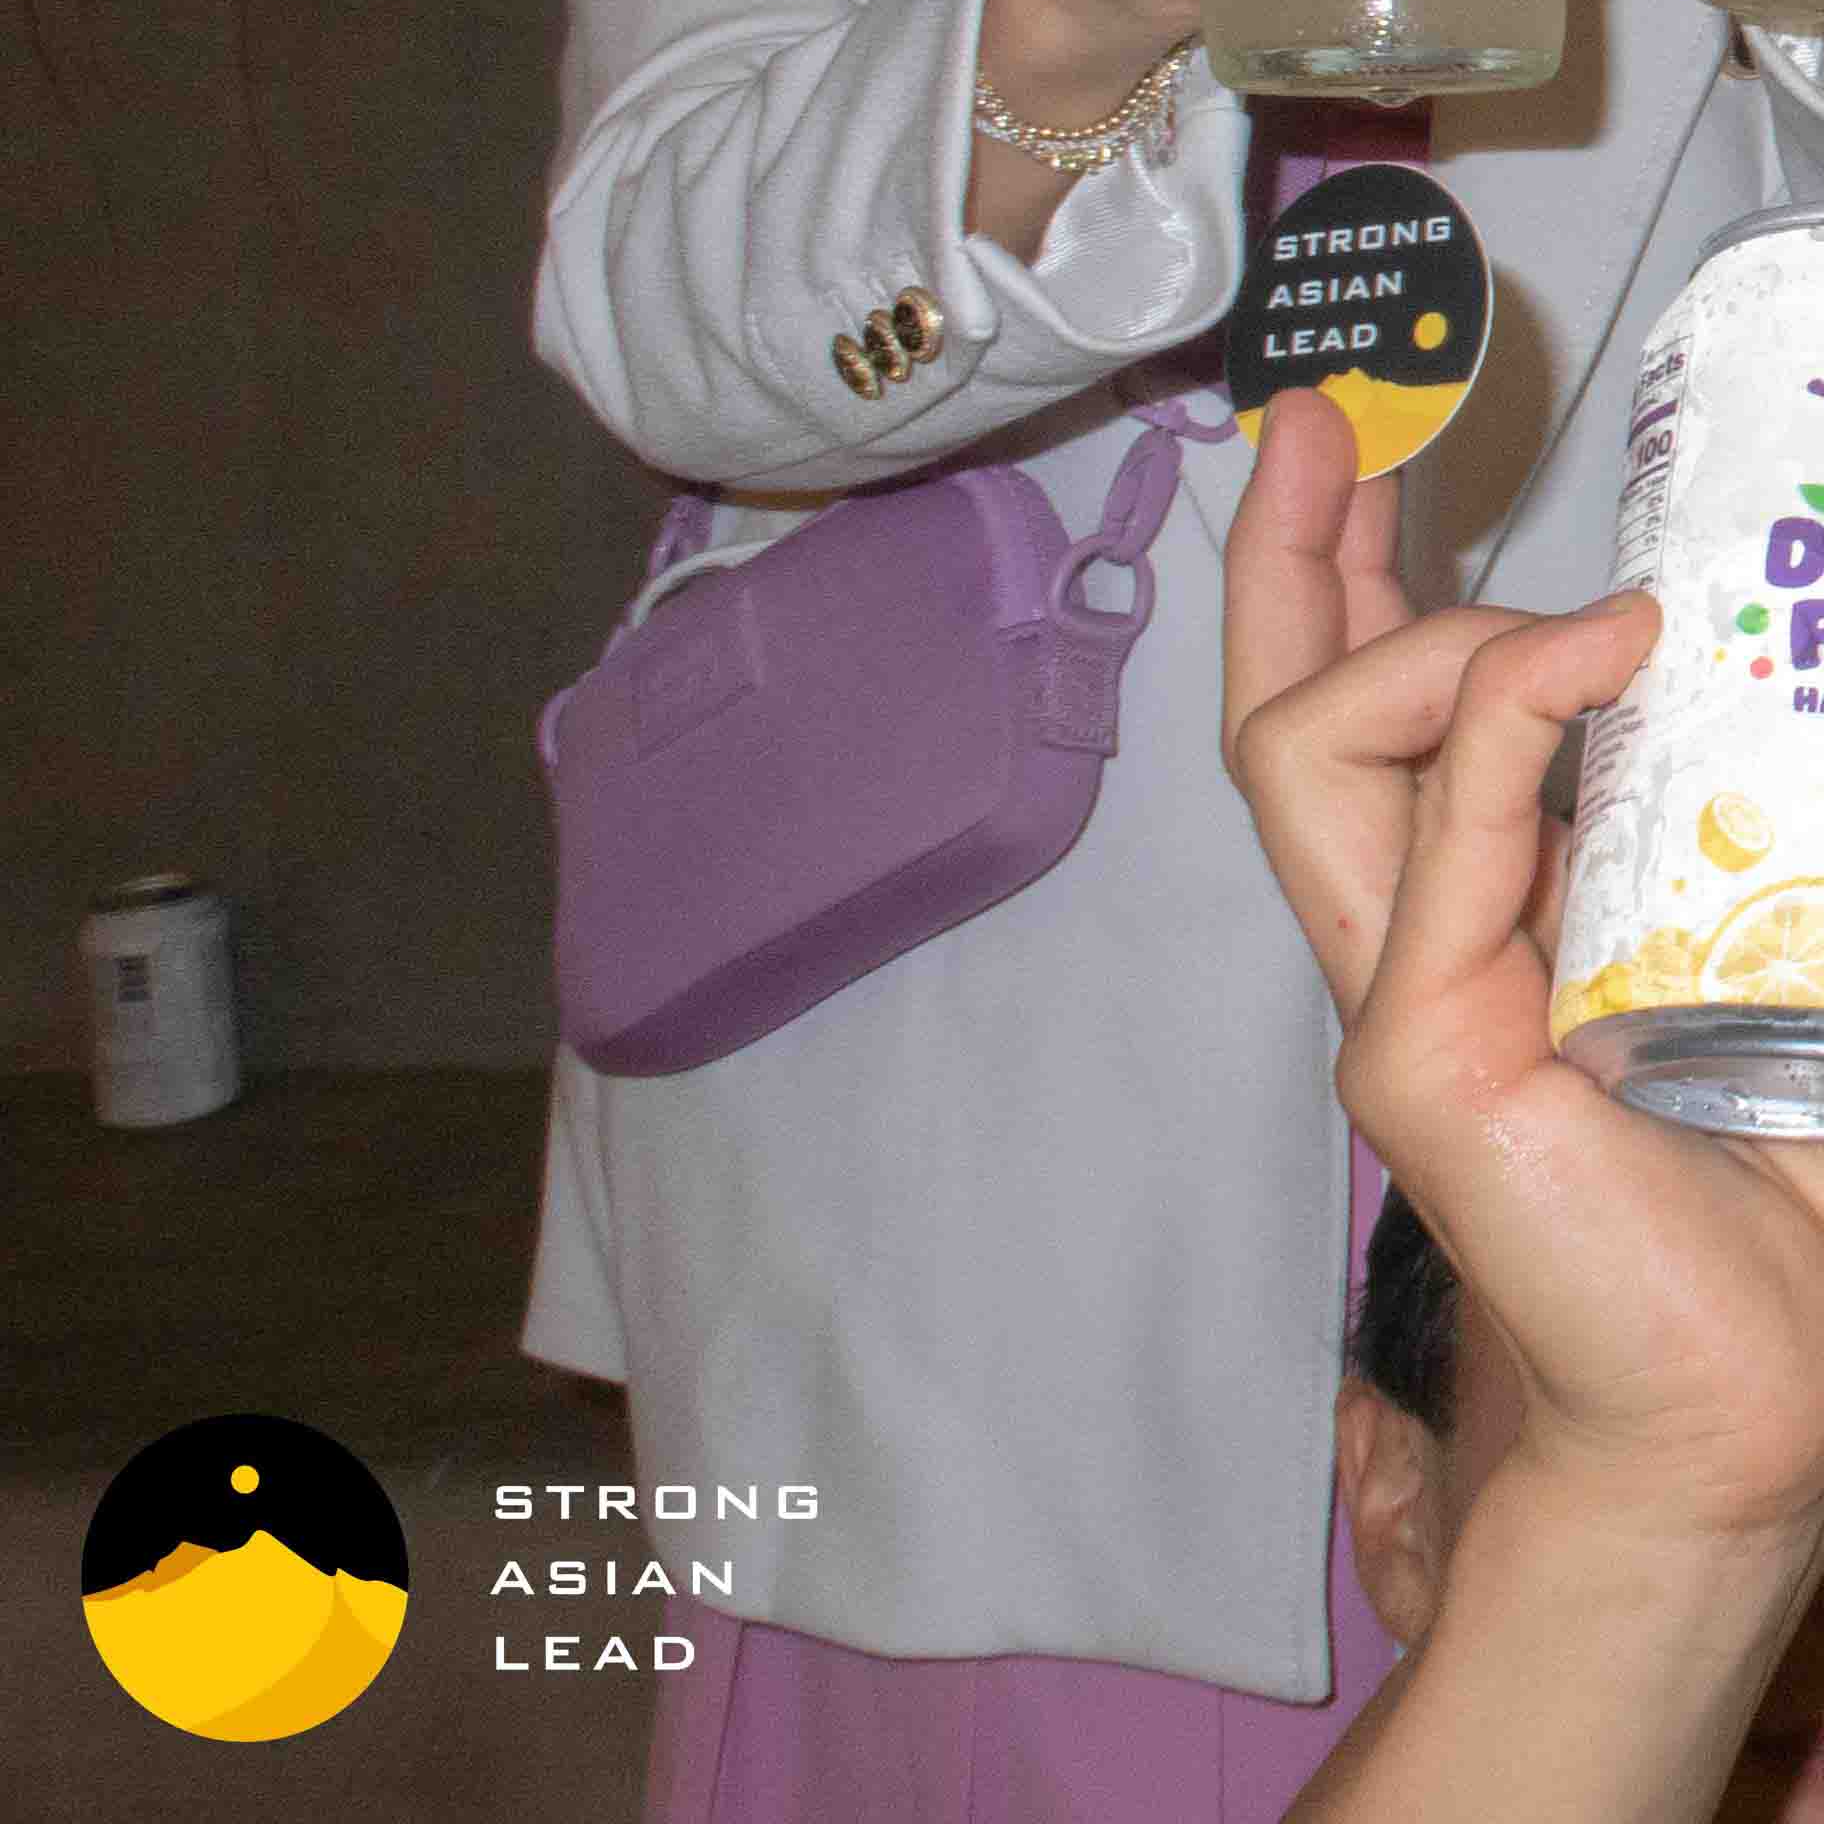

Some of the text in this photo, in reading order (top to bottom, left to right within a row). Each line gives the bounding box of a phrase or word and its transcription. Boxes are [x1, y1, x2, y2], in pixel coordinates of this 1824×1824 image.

[1271, 215, 1453, 262] STRONG
[1267, 270, 1405, 309] ASIAN
[1261, 323, 1379, 359] LEAD
